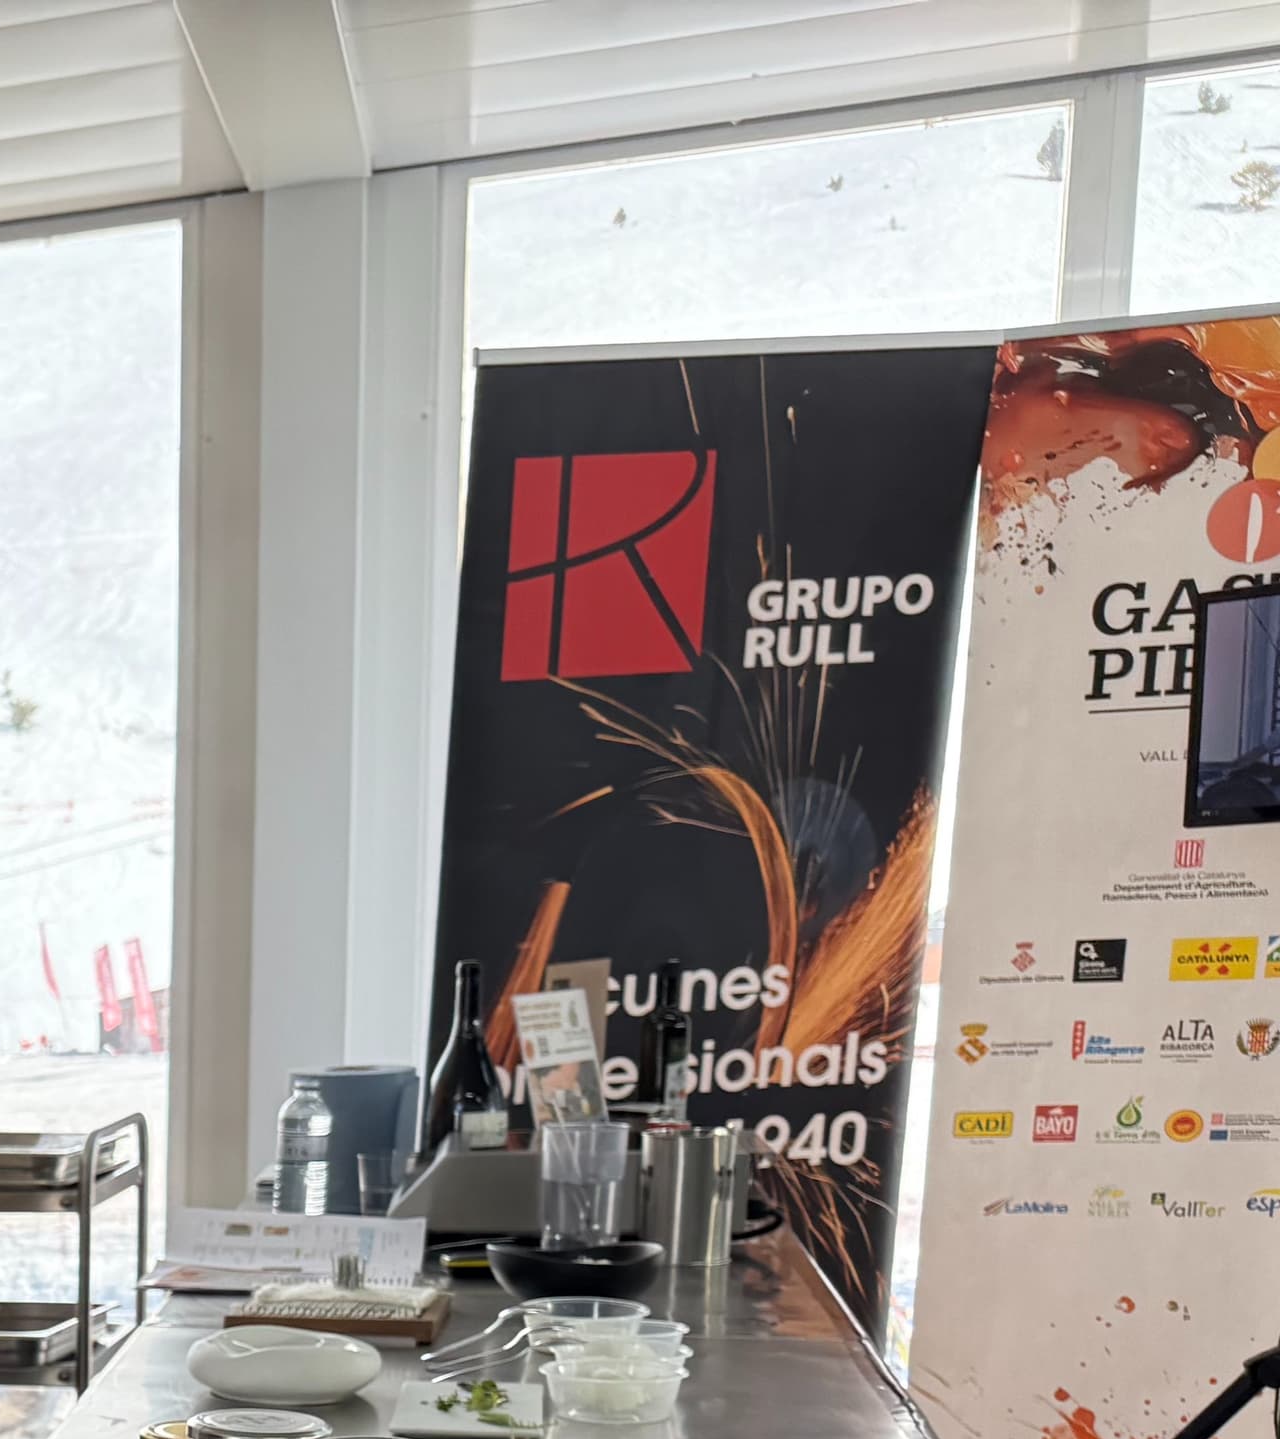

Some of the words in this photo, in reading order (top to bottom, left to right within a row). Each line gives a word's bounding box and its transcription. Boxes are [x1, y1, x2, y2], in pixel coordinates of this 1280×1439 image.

[747, 573, 934, 621] GRUPO
[742, 624, 875, 668] RULL
[1139, 749, 1179, 762] VALL
[1177, 953, 1250, 964] CATALUNYA
[726, 1111, 868, 1168] 940
